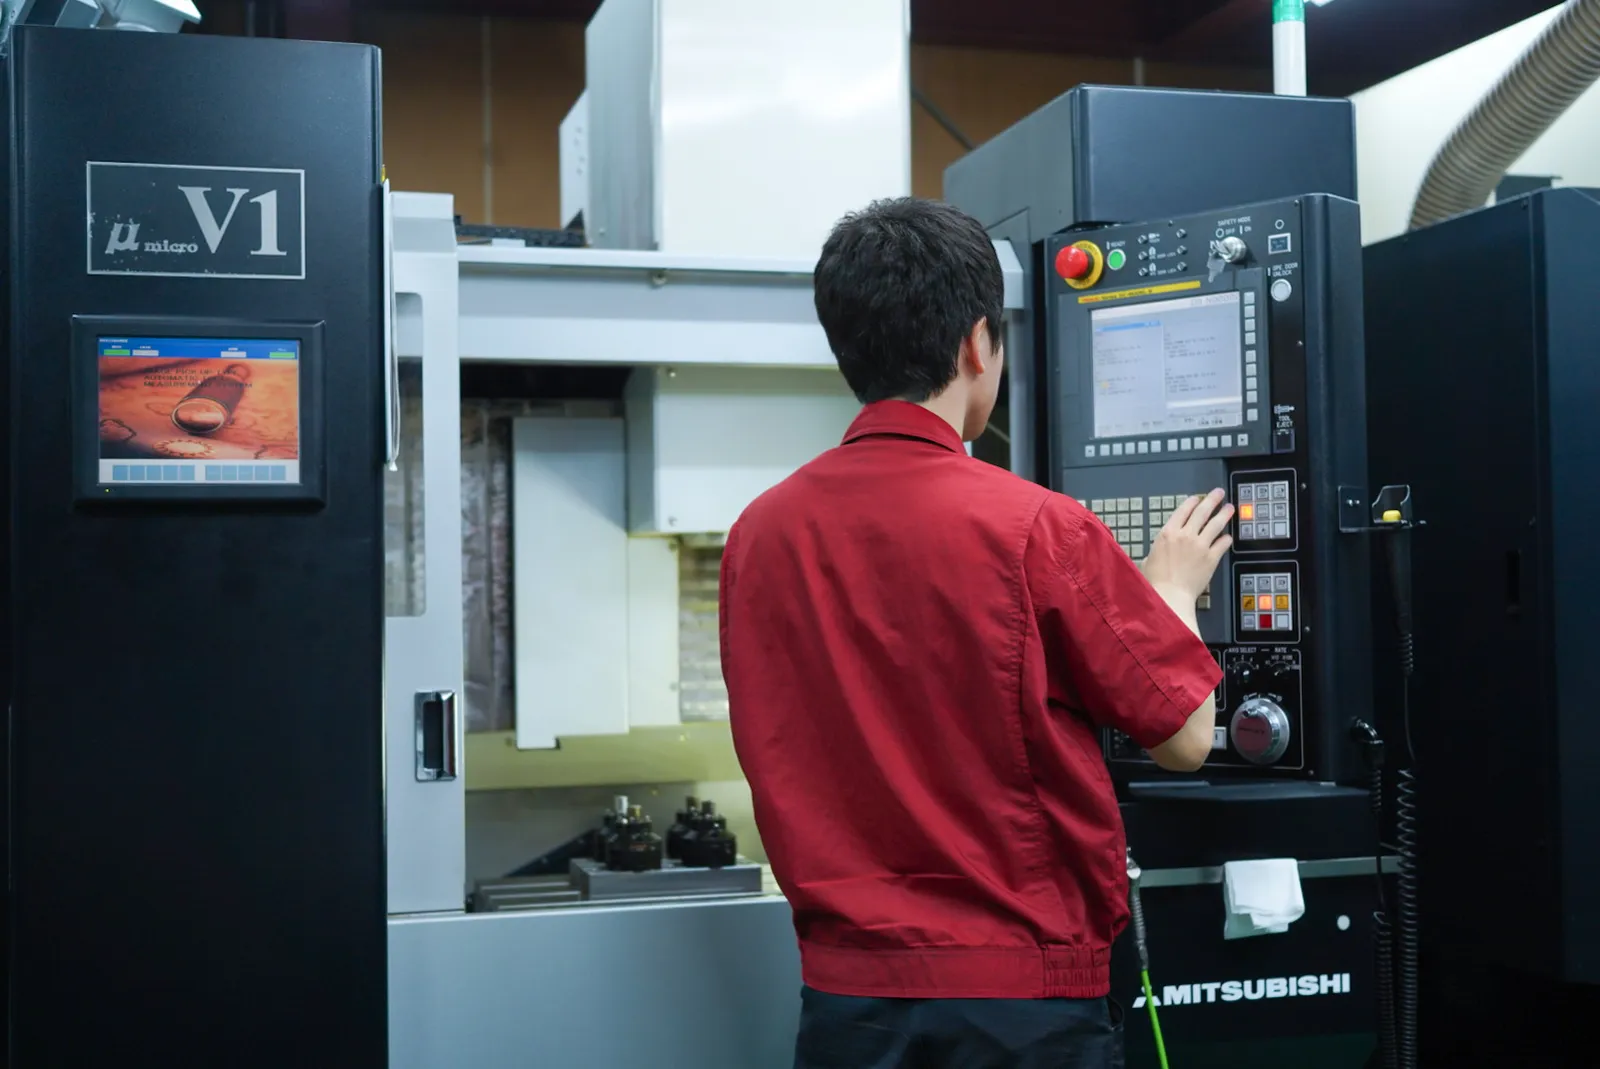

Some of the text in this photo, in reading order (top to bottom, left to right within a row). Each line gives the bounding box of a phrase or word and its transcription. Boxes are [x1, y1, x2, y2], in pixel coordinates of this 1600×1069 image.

[144, 240, 199, 254] micro
[177, 185, 288, 256] V1
[1217, 218, 1237, 227] SAFETY
[1163, 973, 1351, 1006] MITSUBISHI
